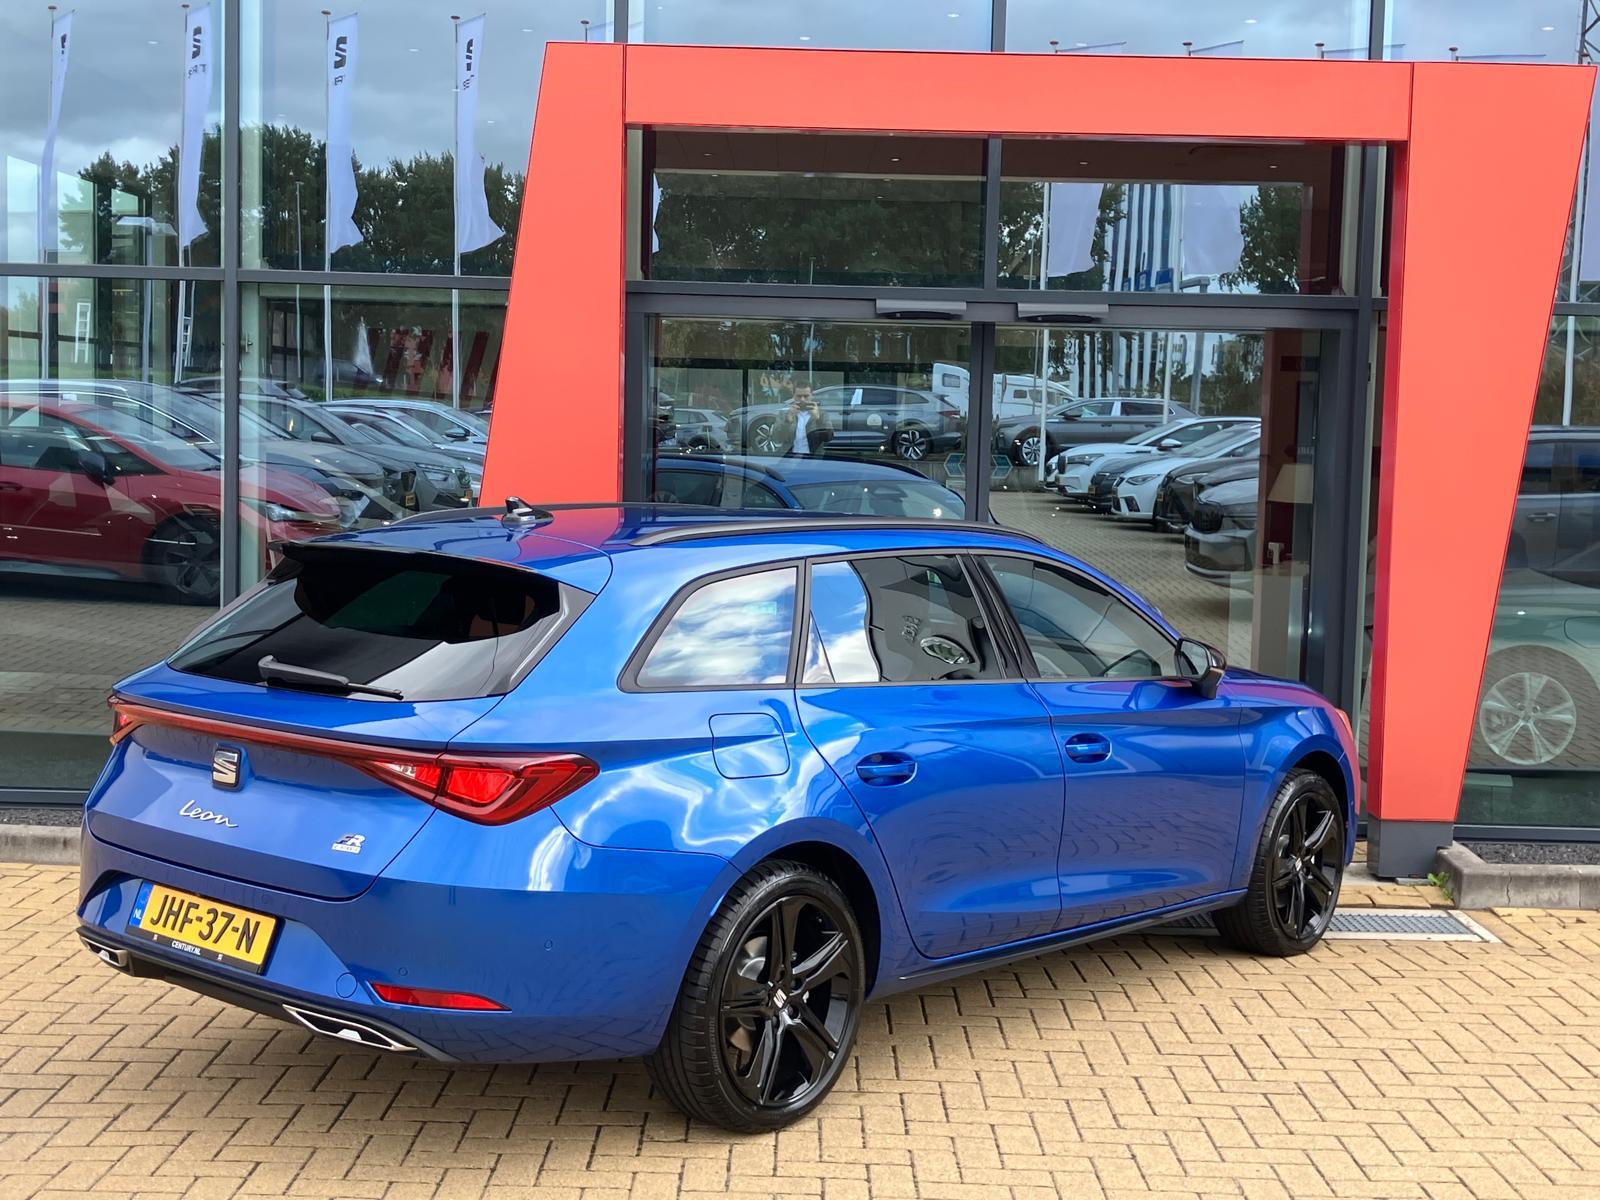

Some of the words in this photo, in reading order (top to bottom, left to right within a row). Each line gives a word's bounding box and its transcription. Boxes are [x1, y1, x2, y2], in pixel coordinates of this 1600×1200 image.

[179, 799, 239, 828] Leon
[133, 908, 142, 920] NL
[150, 894, 261, 954] JHF-37-N
[171, 940, 201, 956] CENTURY.NL
